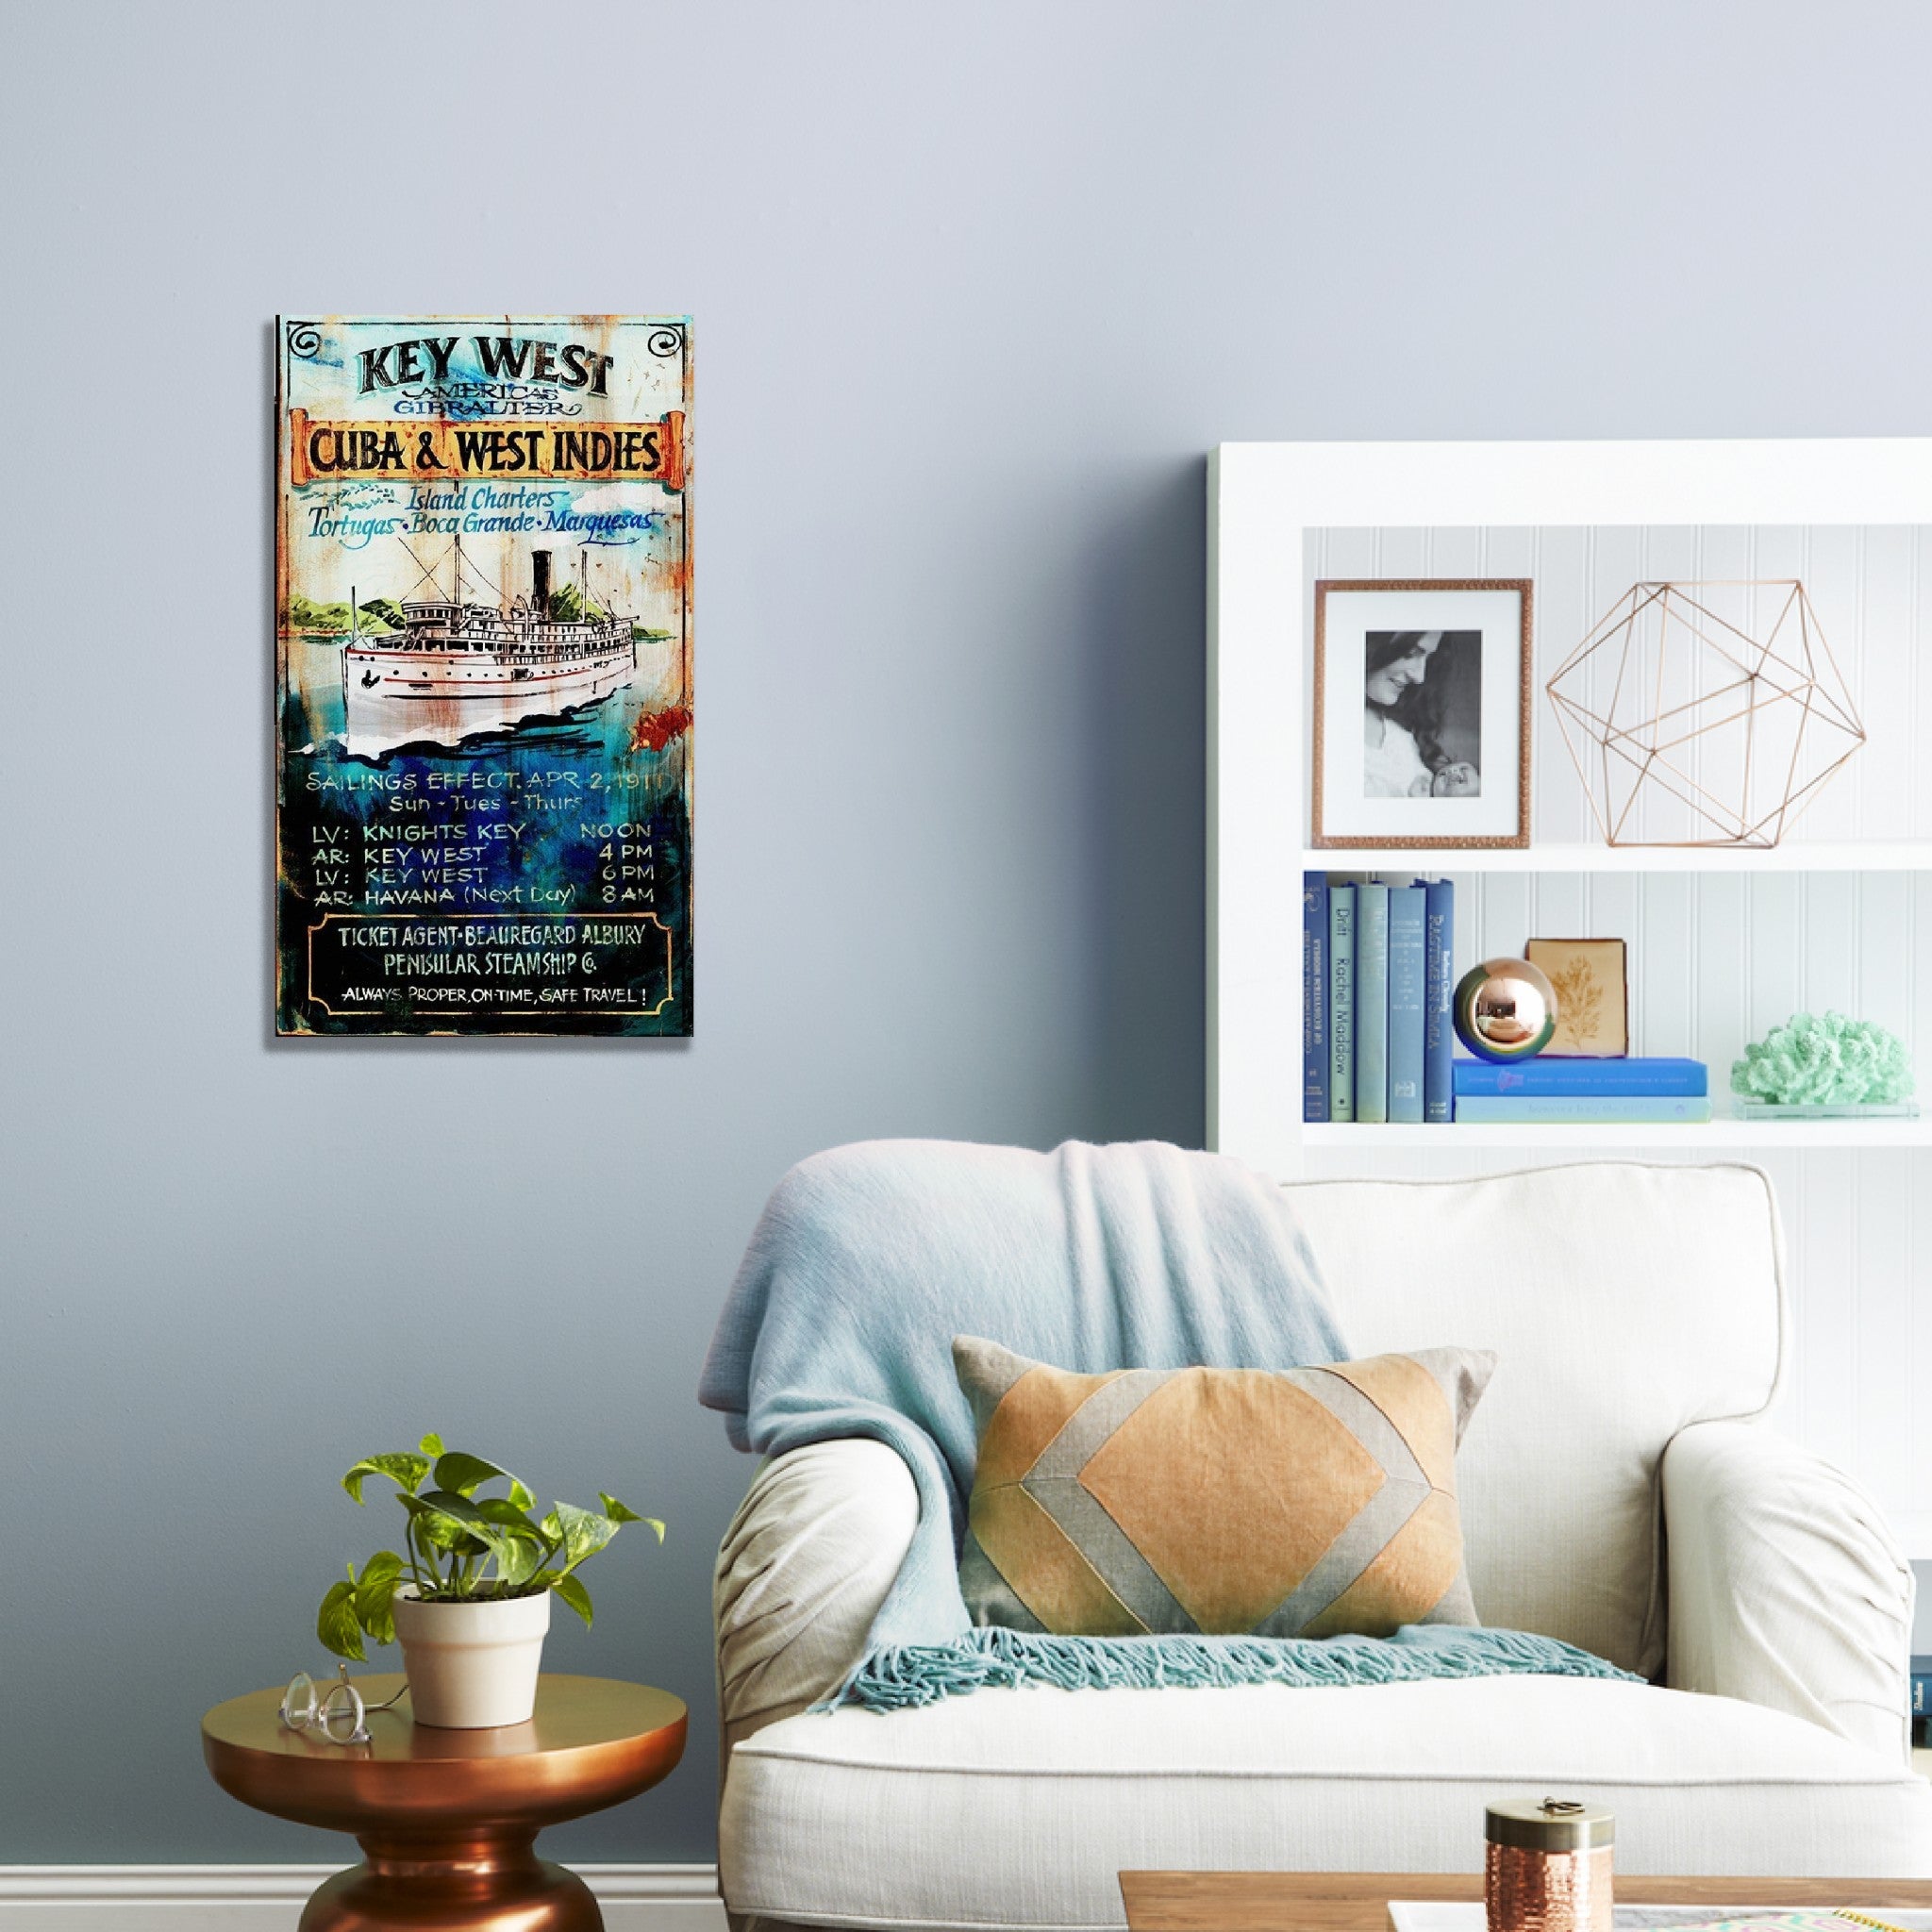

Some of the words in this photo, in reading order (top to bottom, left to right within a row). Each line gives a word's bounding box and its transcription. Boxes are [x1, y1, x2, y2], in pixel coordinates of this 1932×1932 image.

[357, 336, 460, 395] KEY
[472, 336, 614, 397] WEST
[401, 382, 559, 400] AMERICAS
[393, 400, 583, 416] GIBRALTER
[309, 427, 408, 473] CUBA
[415, 430, 451, 470] &
[454, 430, 544, 472] WEST
[552, 430, 661, 472] INDIES
[404, 485, 469, 510] Island
[471, 485, 570, 510] Charters
[308, 506, 406, 550] Tortugas
[407, 511, 460, 535] Boca
[462, 511, 535, 533] Grande
[541, 510, 666, 546] Marquesas
[306, 772, 418, 791] SAILINGS
[425, 772, 522, 791] EFFECT.
[525, 771, 580, 789] APR
[389, 795, 431, 812] Sun
[450, 795, 501, 812] Tues
[524, 793, 583, 811] Thurs
[312, 825, 349, 843] LV:
[362, 824, 468, 841] KNIGHTS
[477, 823, 526, 841] KEY
[580, 823, 651, 839] NOON
[311, 847, 350, 865] AR:
[364, 846, 414, 866] KEY
[421, 846, 487, 865] WEST
[599, 842, 614, 861] 4
[621, 844, 653, 858] PM
[315, 868, 349, 887] LV:
[365, 867, 414, 884] KEY
[421, 867, 489, 884] WEST
[602, 864, 616, 881] 6
[622, 864, 655, 880] PM
[364, 888, 455, 906] HAVANA
[602, 885, 617, 904] 8
[621, 887, 655, 903] AM
[338, 925, 401, 947] TICKET
[581, 924, 646, 945] ALBURY
[384, 953, 481, 975] PENISULAR
[484, 951, 577, 975] STEAMSHIP
[1336, 958, 1351, 1005] Rachel
[341, 987, 403, 1002] ALWAYS
[539, 988, 579, 1003] SAFE
[1336, 1010, 1351, 1075] Maddow
